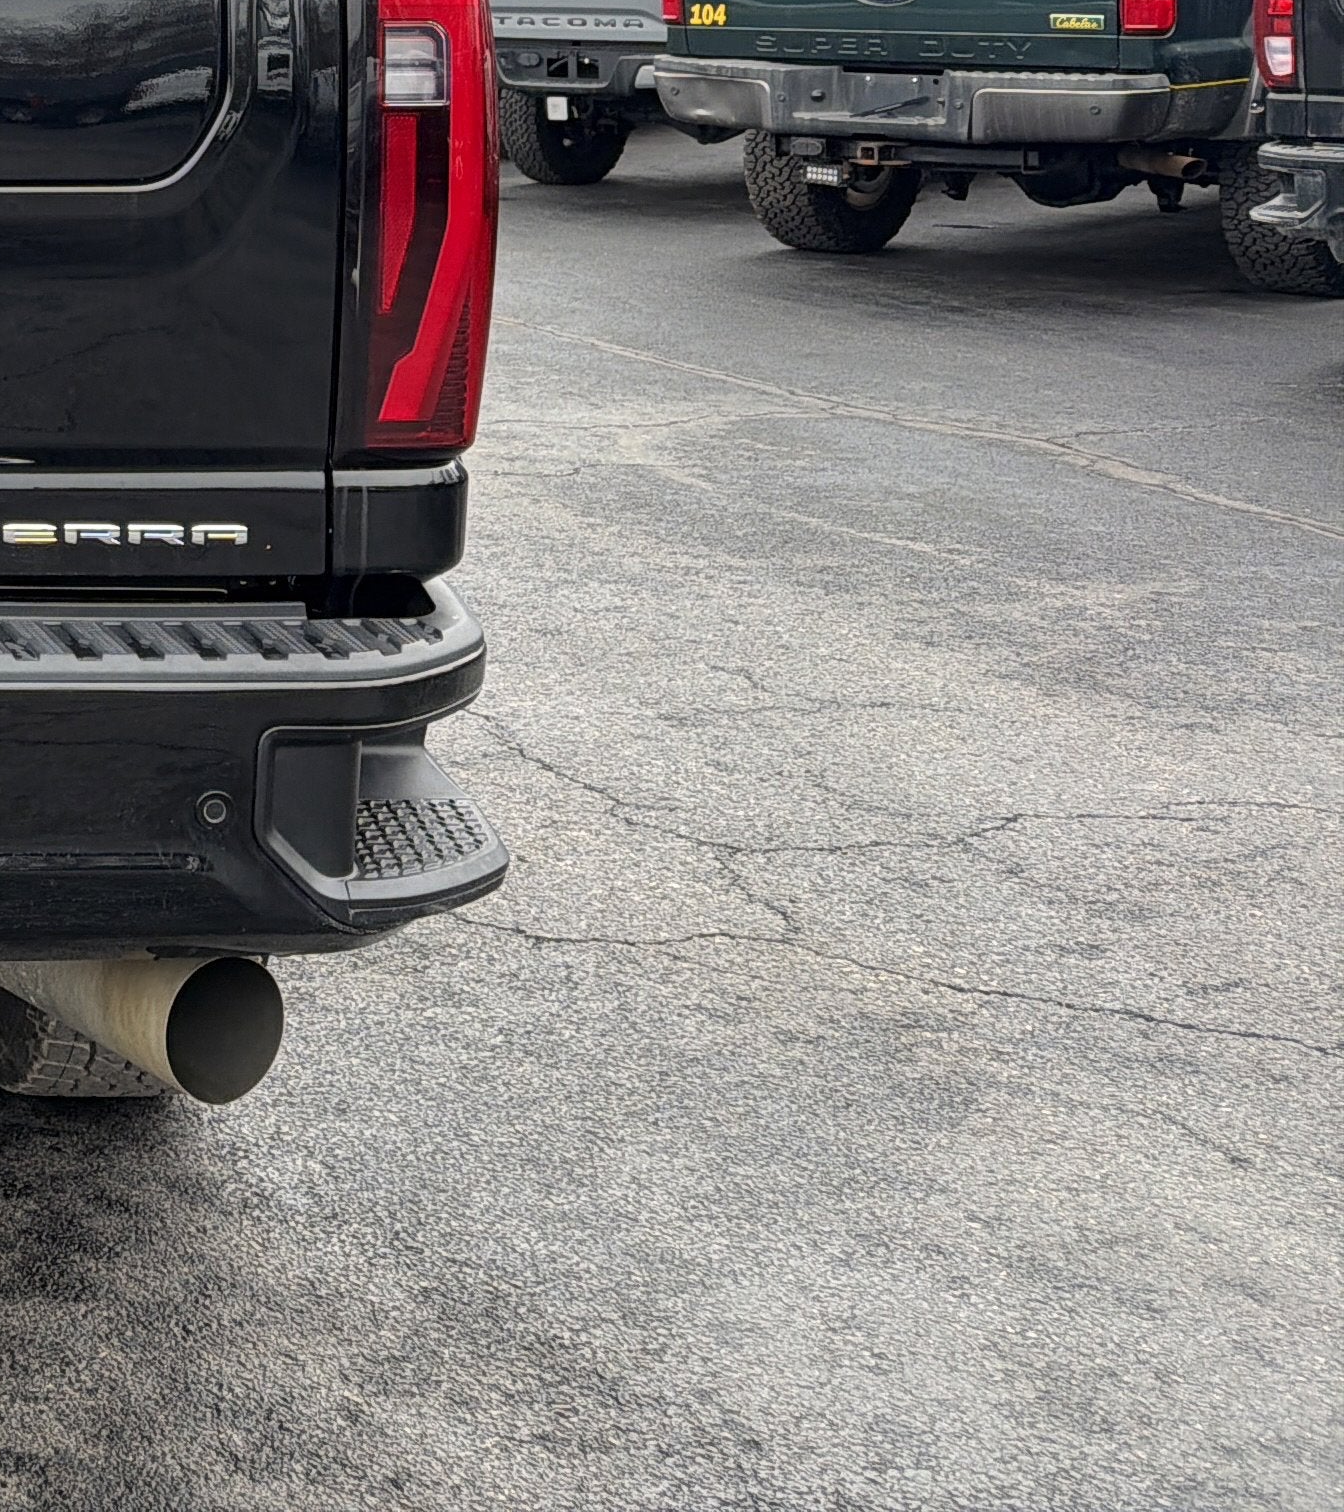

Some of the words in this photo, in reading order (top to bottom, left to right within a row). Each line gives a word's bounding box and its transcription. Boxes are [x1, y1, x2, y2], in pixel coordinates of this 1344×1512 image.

[493, 16, 644, 29] TACOMA
[689, 3, 727, 26] 104
[755, 35, 889, 56] SUPER
[918, 39, 1032, 60] DUTY
